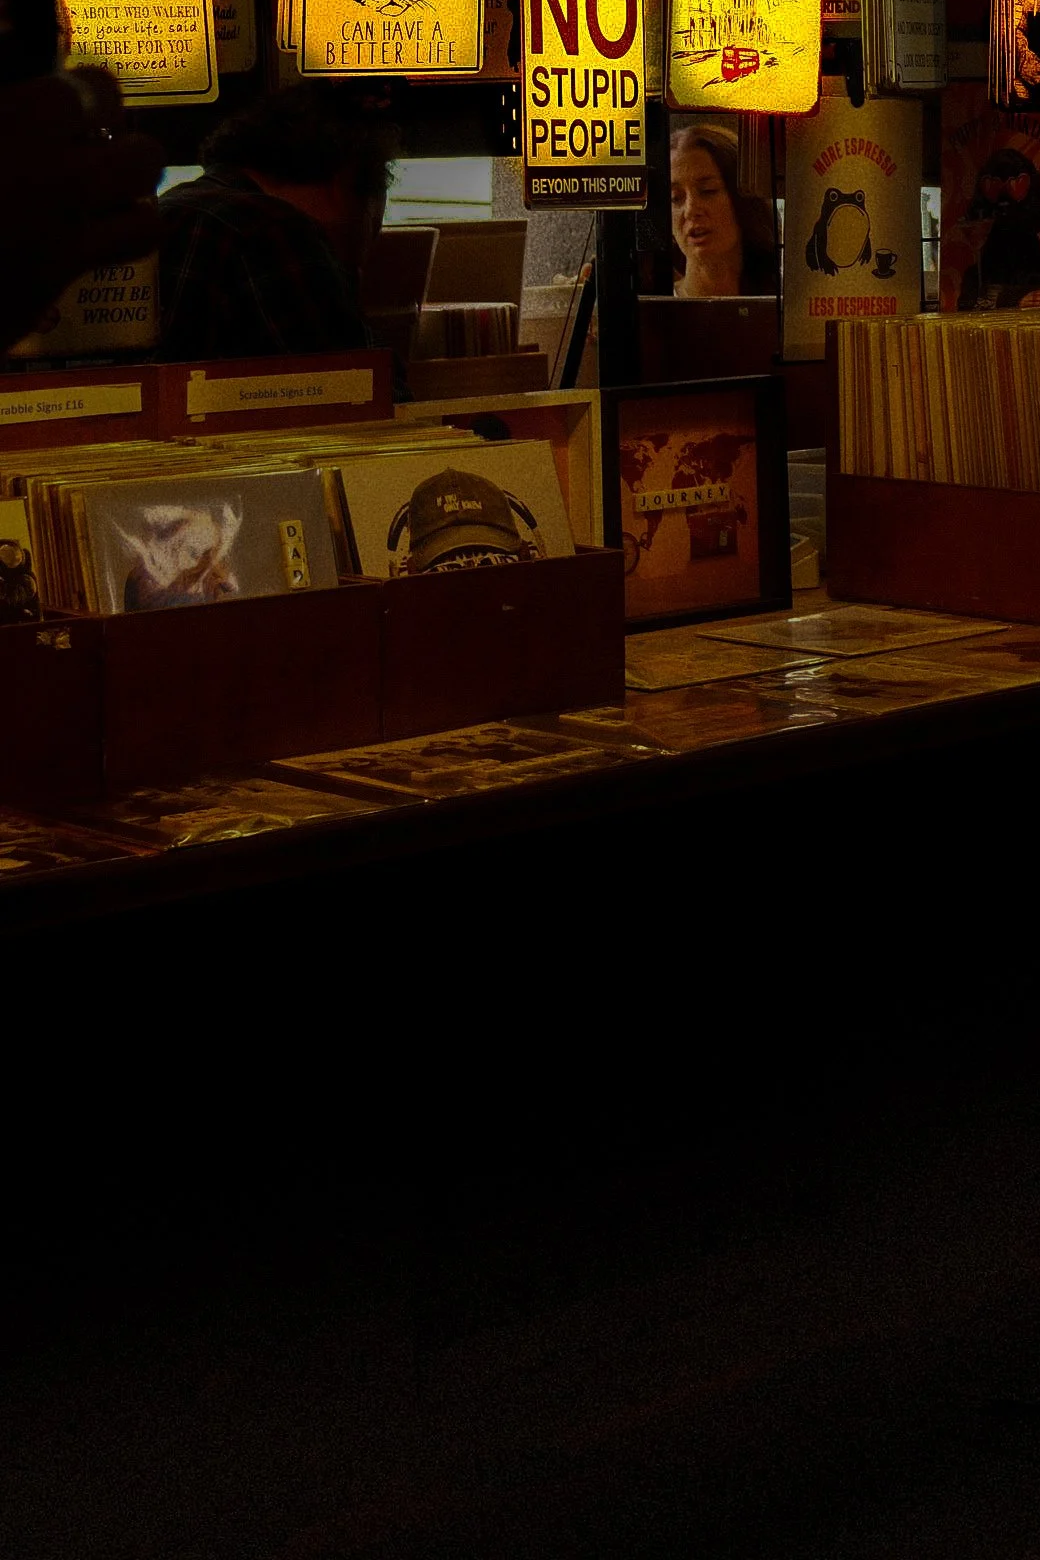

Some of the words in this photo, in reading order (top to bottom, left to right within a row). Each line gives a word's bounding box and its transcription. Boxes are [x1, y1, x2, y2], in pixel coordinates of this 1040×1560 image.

[83, 6, 121, 19] ABOUT
[124, 5, 150, 19] WHO
[153, 5, 200, 19] WALKED
[96, 25, 130, 40] your
[168, 23, 198, 34] said
[341, 20, 374, 42] CAN
[382, 20, 424, 42] HAVE
[431, 20, 444, 41] A
[93, 40, 132, 56] HERE
[136, 40, 164, 54] FOR
[167, 39, 193, 53] YOU
[325, 41, 404, 65] BETTER
[416, 40, 457, 65] LIFE
[114, 59, 168, 76] proved
[174, 58, 188, 69] it
[531, 65, 639, 110] STUPID
[531, 118, 642, 158] PEOPLE
[812, 141, 843, 177] MORE
[844, 137, 898, 177] ESPRESSO
[532, 176, 579, 195] BEYOND
[581, 177, 607, 194] THIS
[609, 176, 642, 193] POINT
[93, 266, 136, 282] WE'D
[77, 286, 126, 304] BOTH
[130, 285, 152, 302] BE
[82, 306, 148, 325] WRONG
[808, 296, 835, 317] LESS
[836, 296, 898, 316] DESPRESSO
[239, 386, 278, 401] Scrabble
[280, 386, 305, 400] Signs
[307, 385, 323, 397] £16
[36, 401, 63, 414] Signs
[65, 399, 84, 410] £16
[640, 486, 726, 507] JOURNEY
